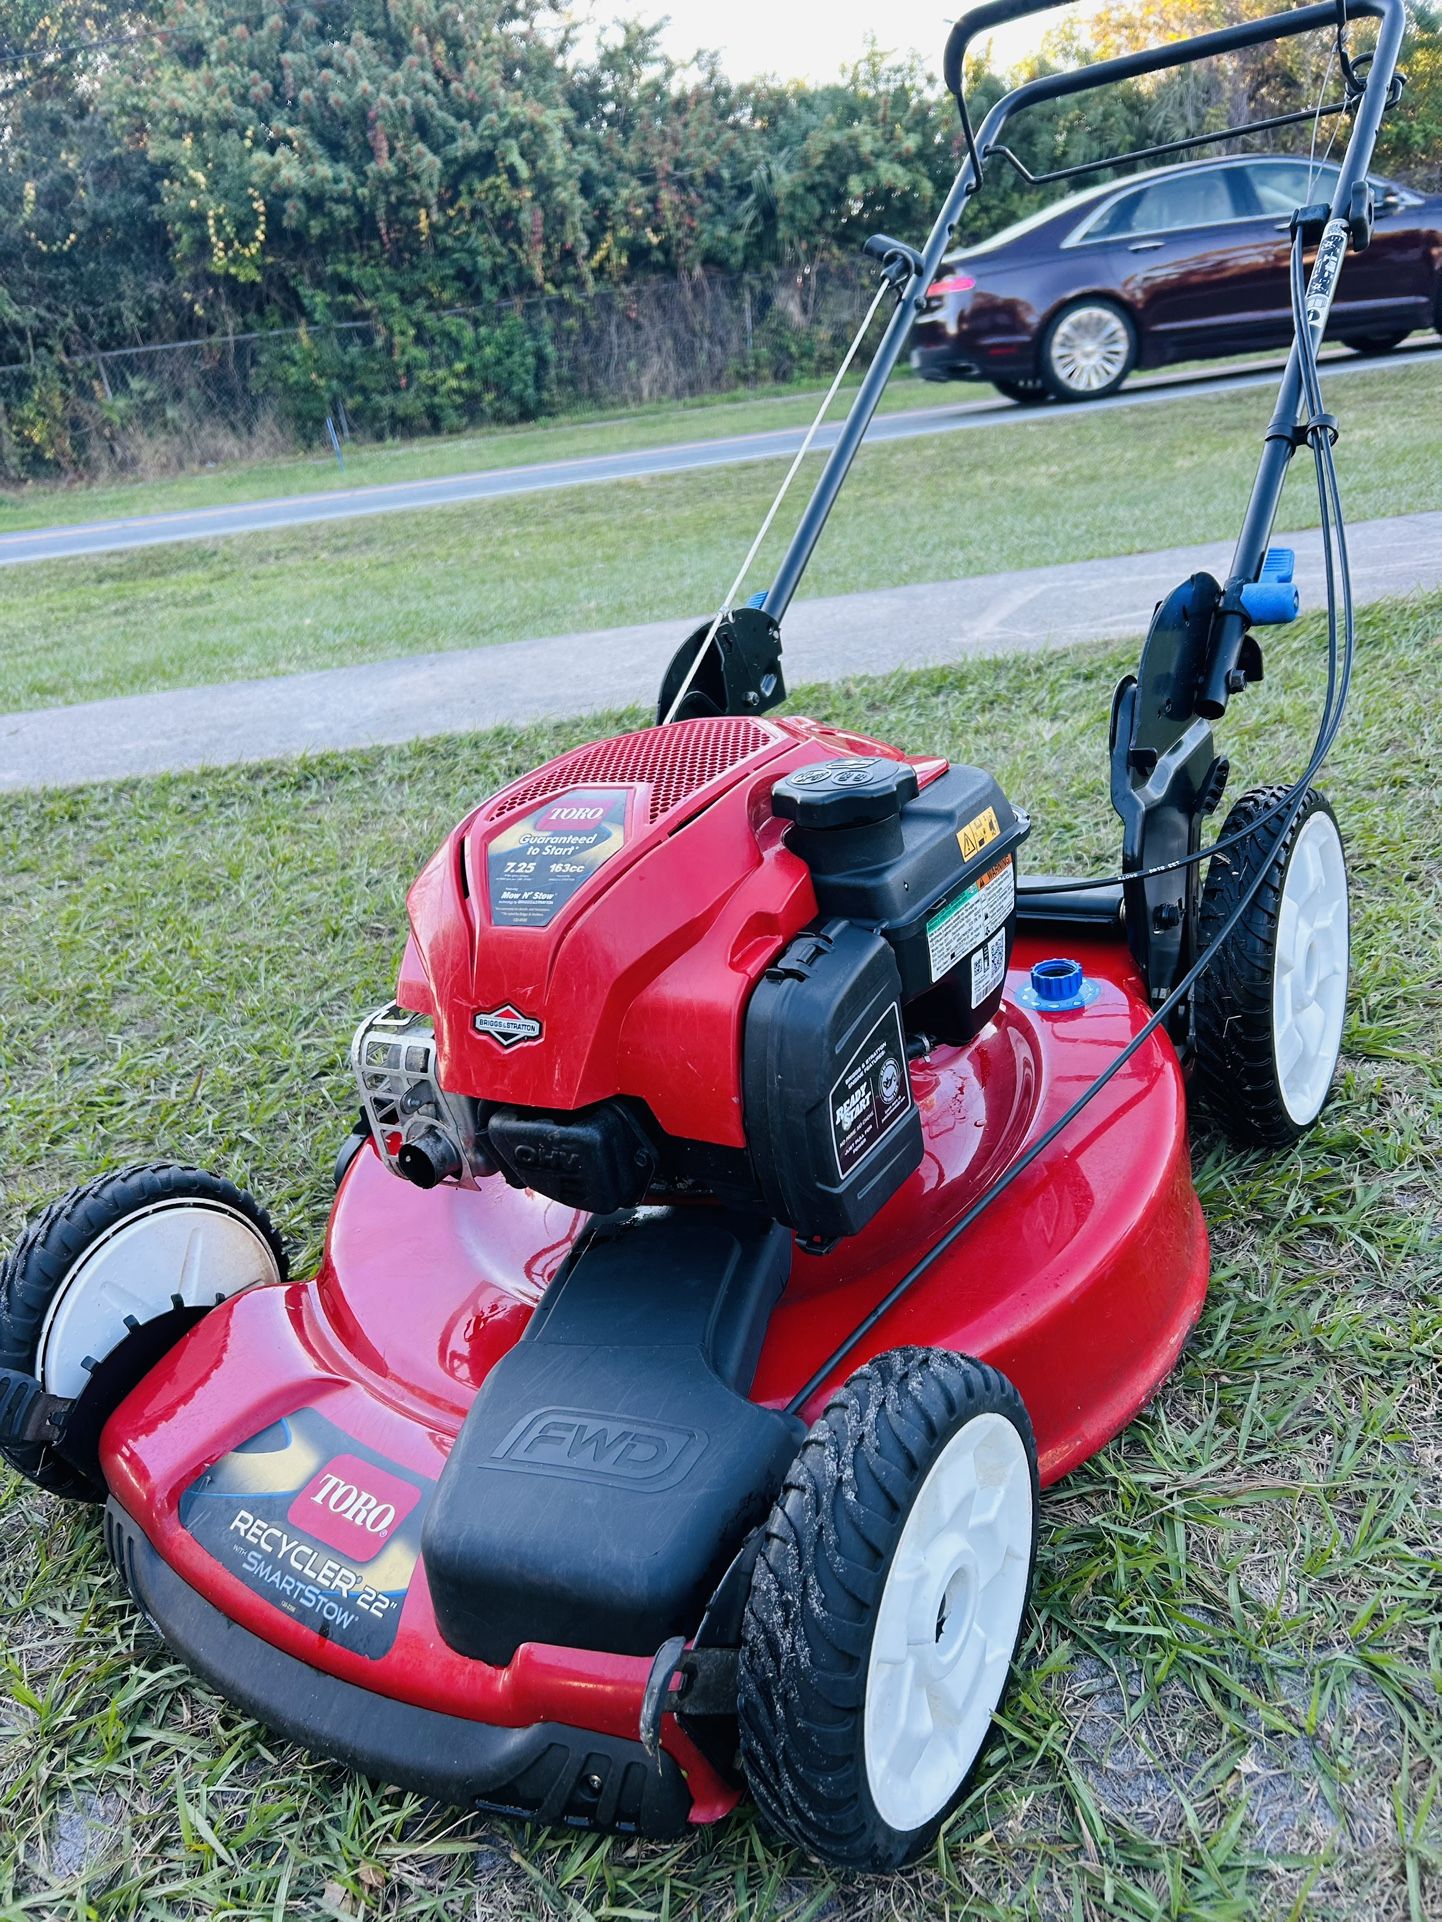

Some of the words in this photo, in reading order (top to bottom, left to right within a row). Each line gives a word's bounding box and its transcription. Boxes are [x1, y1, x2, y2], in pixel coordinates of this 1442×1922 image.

[549, 807, 603, 820] TORO
[519, 834, 598, 845] Guaranteed
[526, 846, 540, 856] to
[503, 862, 536, 874] 7.25
[549, 863, 585, 873] 163cc
[501, 891, 521, 899] Mow
[532, 891, 555, 899] Stow
[835, 1081, 868, 1125] READY
[842, 1090, 872, 1131] START
[523, 1421, 669, 1466] FWD
[311, 1473, 395, 1533] TORO
[232, 1543, 248, 1557] WITH
